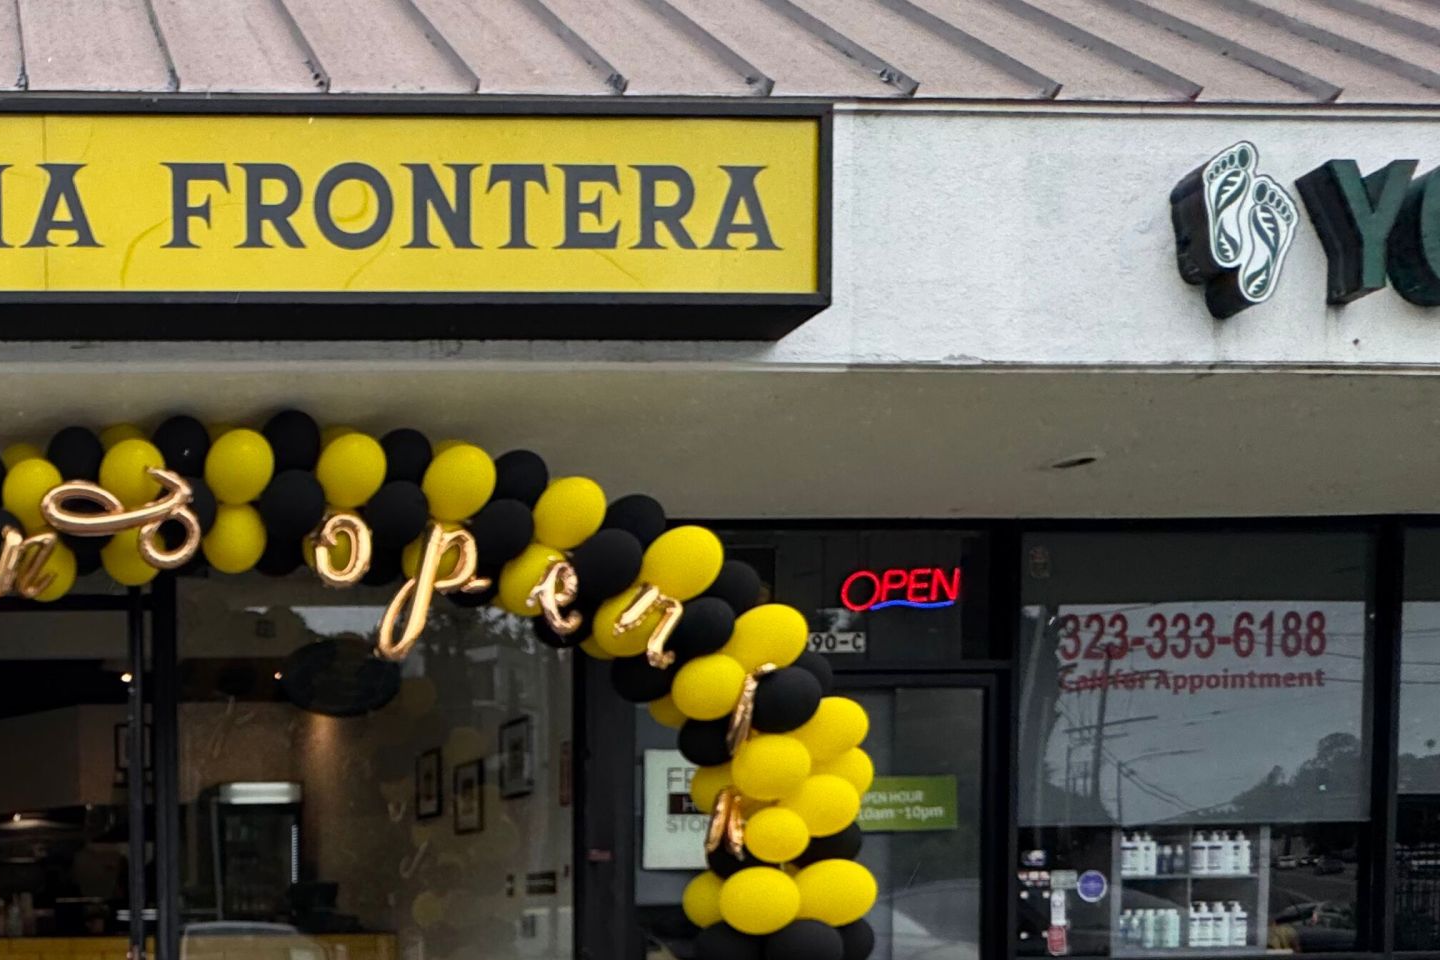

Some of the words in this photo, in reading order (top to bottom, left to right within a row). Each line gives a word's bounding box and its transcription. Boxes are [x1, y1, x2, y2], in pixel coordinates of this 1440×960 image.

[162, 162, 783, 251] FRONTERA
[841, 567, 961, 612] OPEN
[809, 633, 864, 651] 90-C
[1058, 609, 1327, 661] 323-333-6188
[1154, 668, 1327, 695] Appointment
